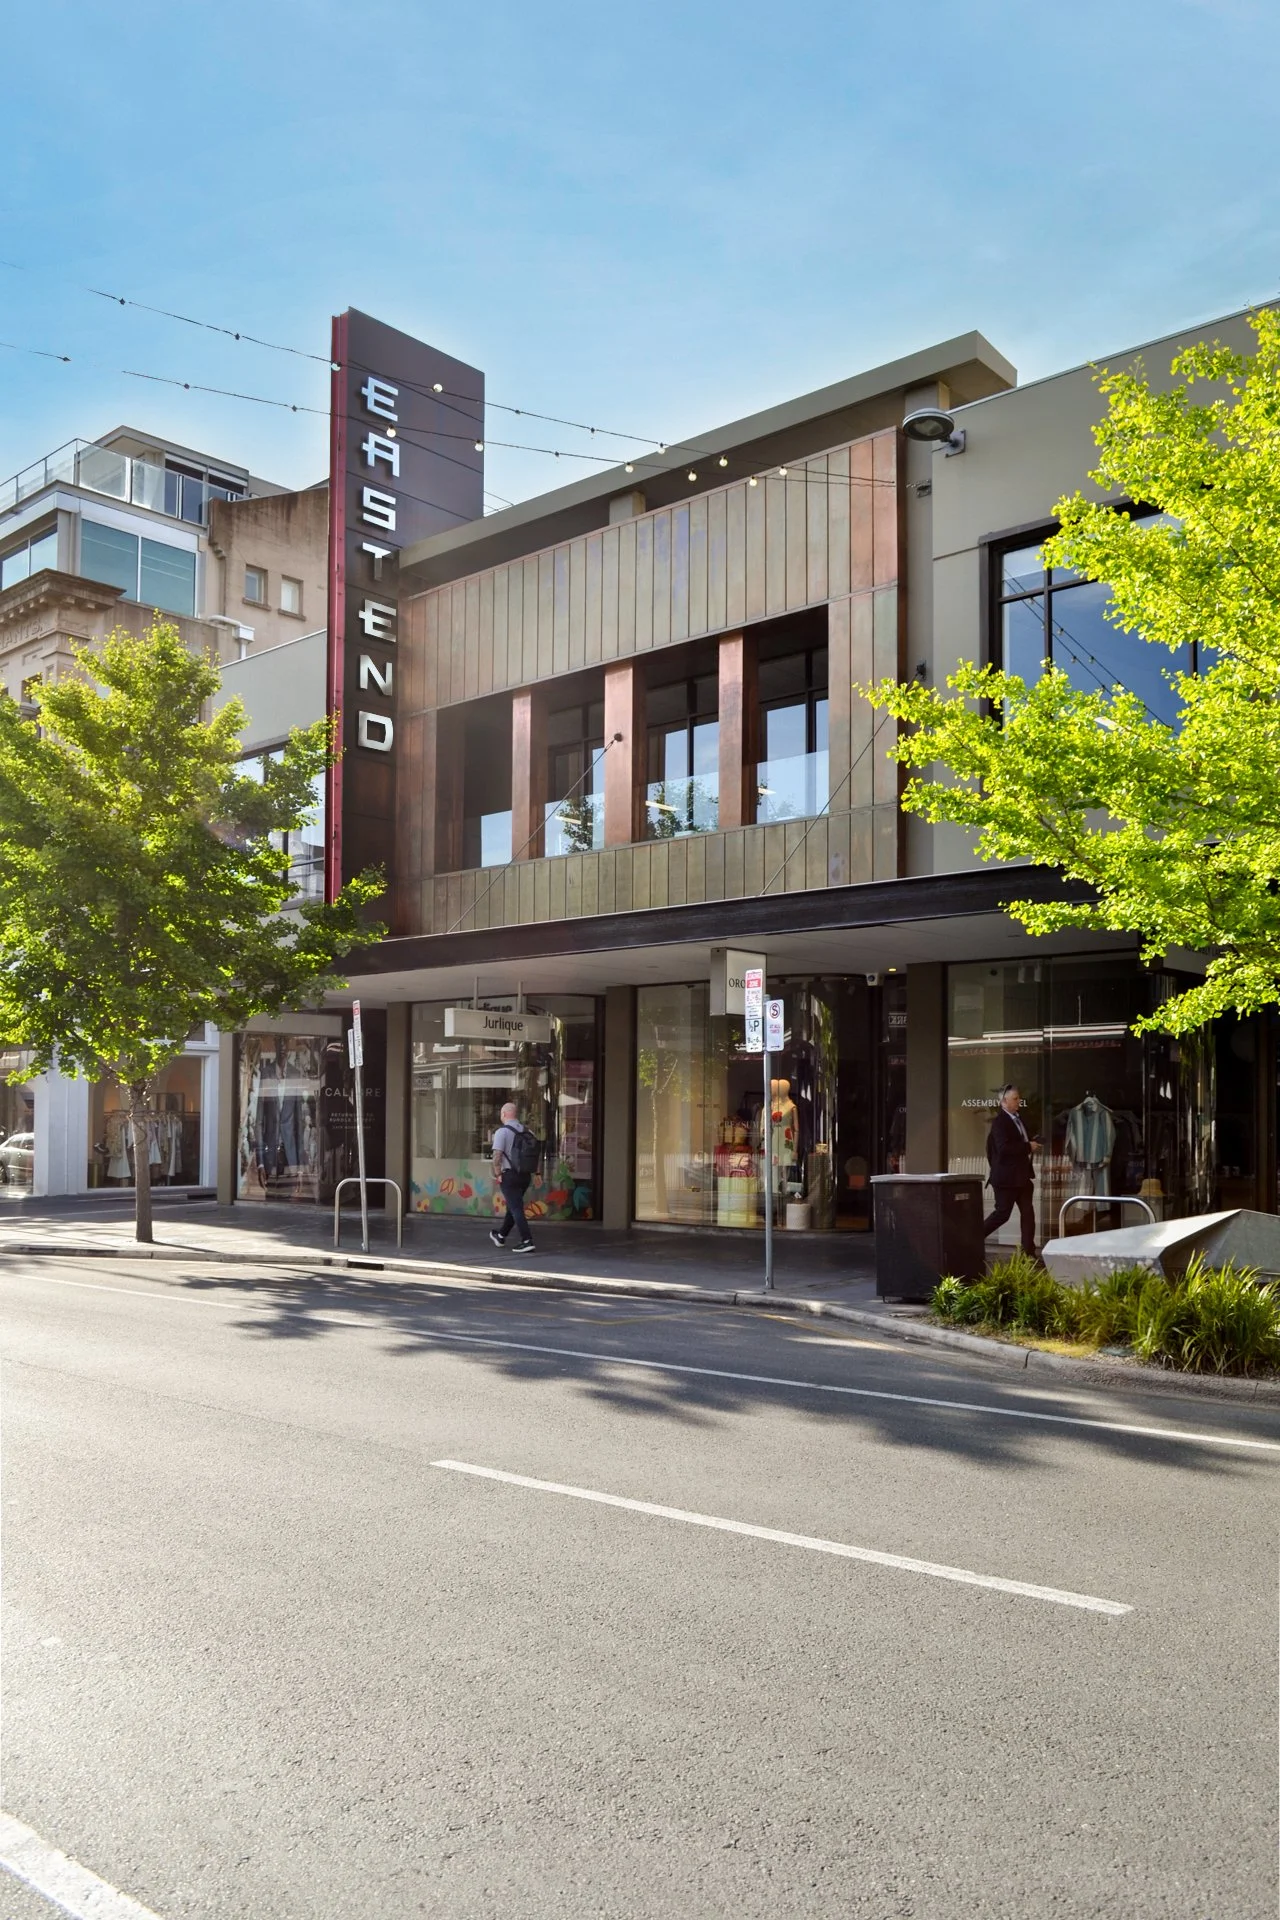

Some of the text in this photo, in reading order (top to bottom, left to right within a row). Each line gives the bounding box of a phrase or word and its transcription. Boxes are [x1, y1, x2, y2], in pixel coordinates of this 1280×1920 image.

[358, 376, 400, 752] EAST END
[483, 1015, 524, 1036] Jurlique
[325, 1087, 380, 1097] CALIRE
[961, 1099, 1000, 1107] ASSEMBLY
